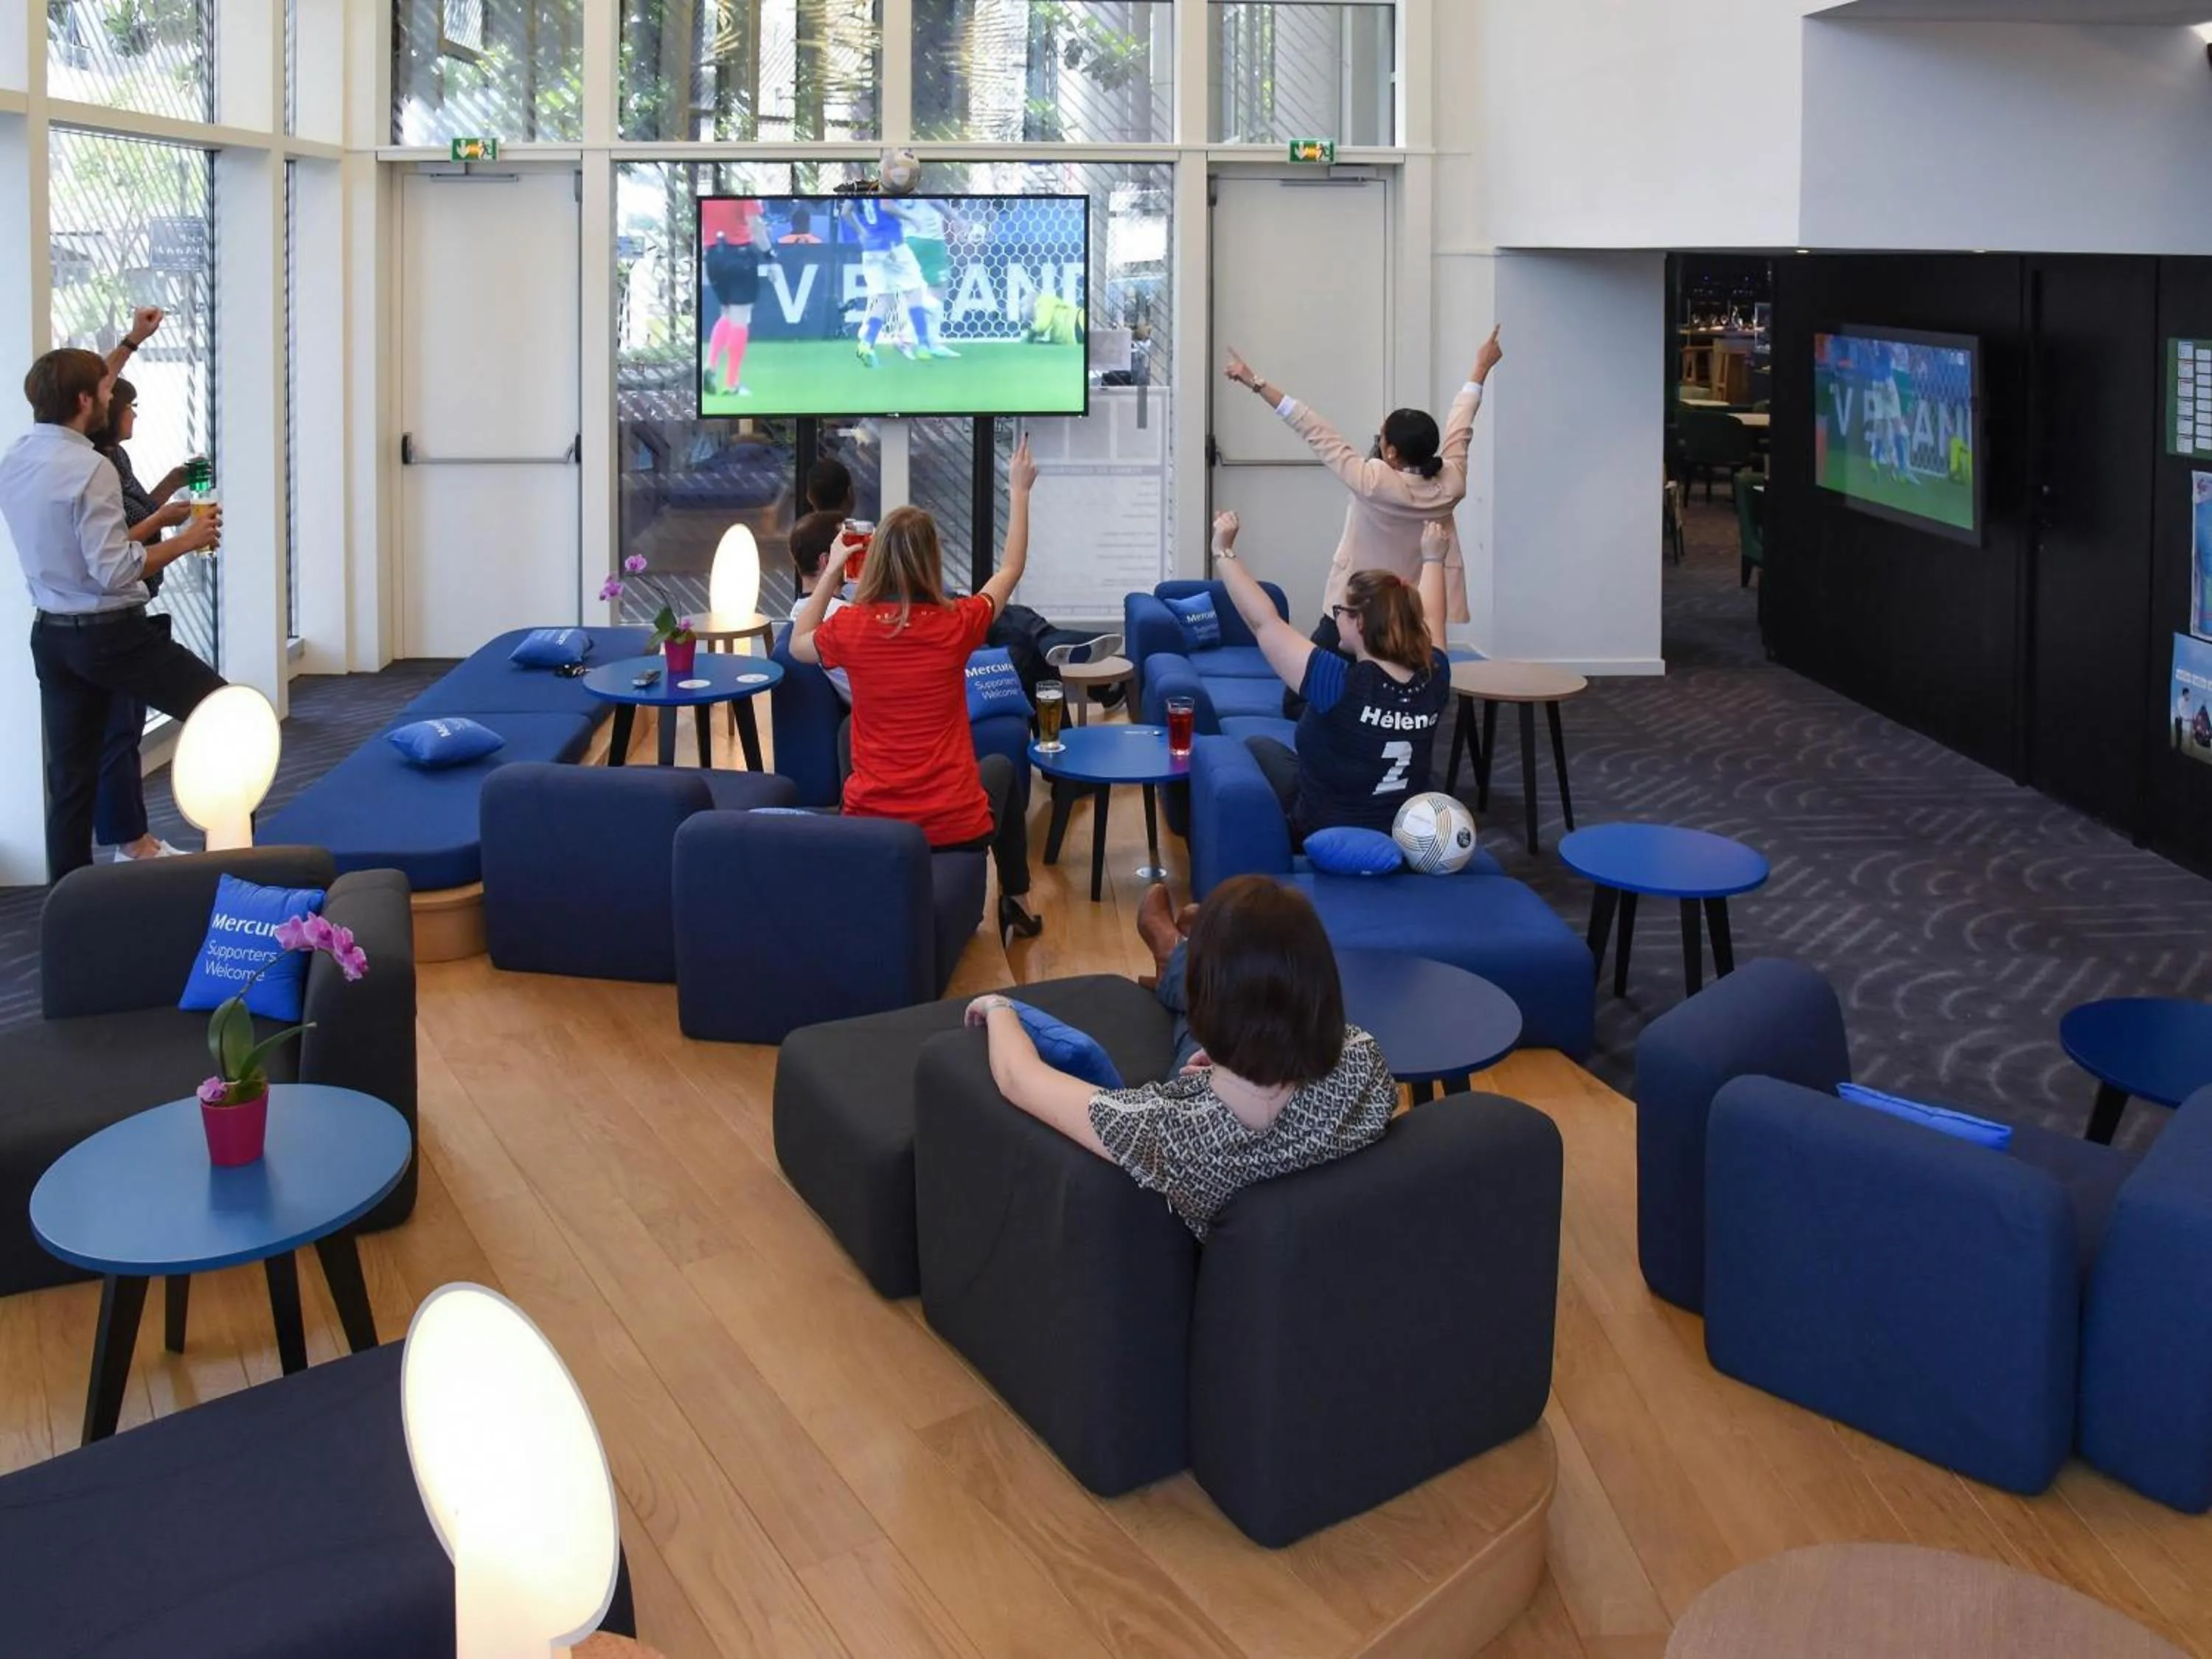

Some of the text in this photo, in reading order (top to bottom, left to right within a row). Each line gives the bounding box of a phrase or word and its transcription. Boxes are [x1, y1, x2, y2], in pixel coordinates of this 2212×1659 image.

[758, 263, 819, 324] V
[1372, 741, 1413, 796] 2
[212, 913, 279, 937] Mercur
[207, 939, 278, 963] Supporters
[205, 959, 265, 981] Welcome
